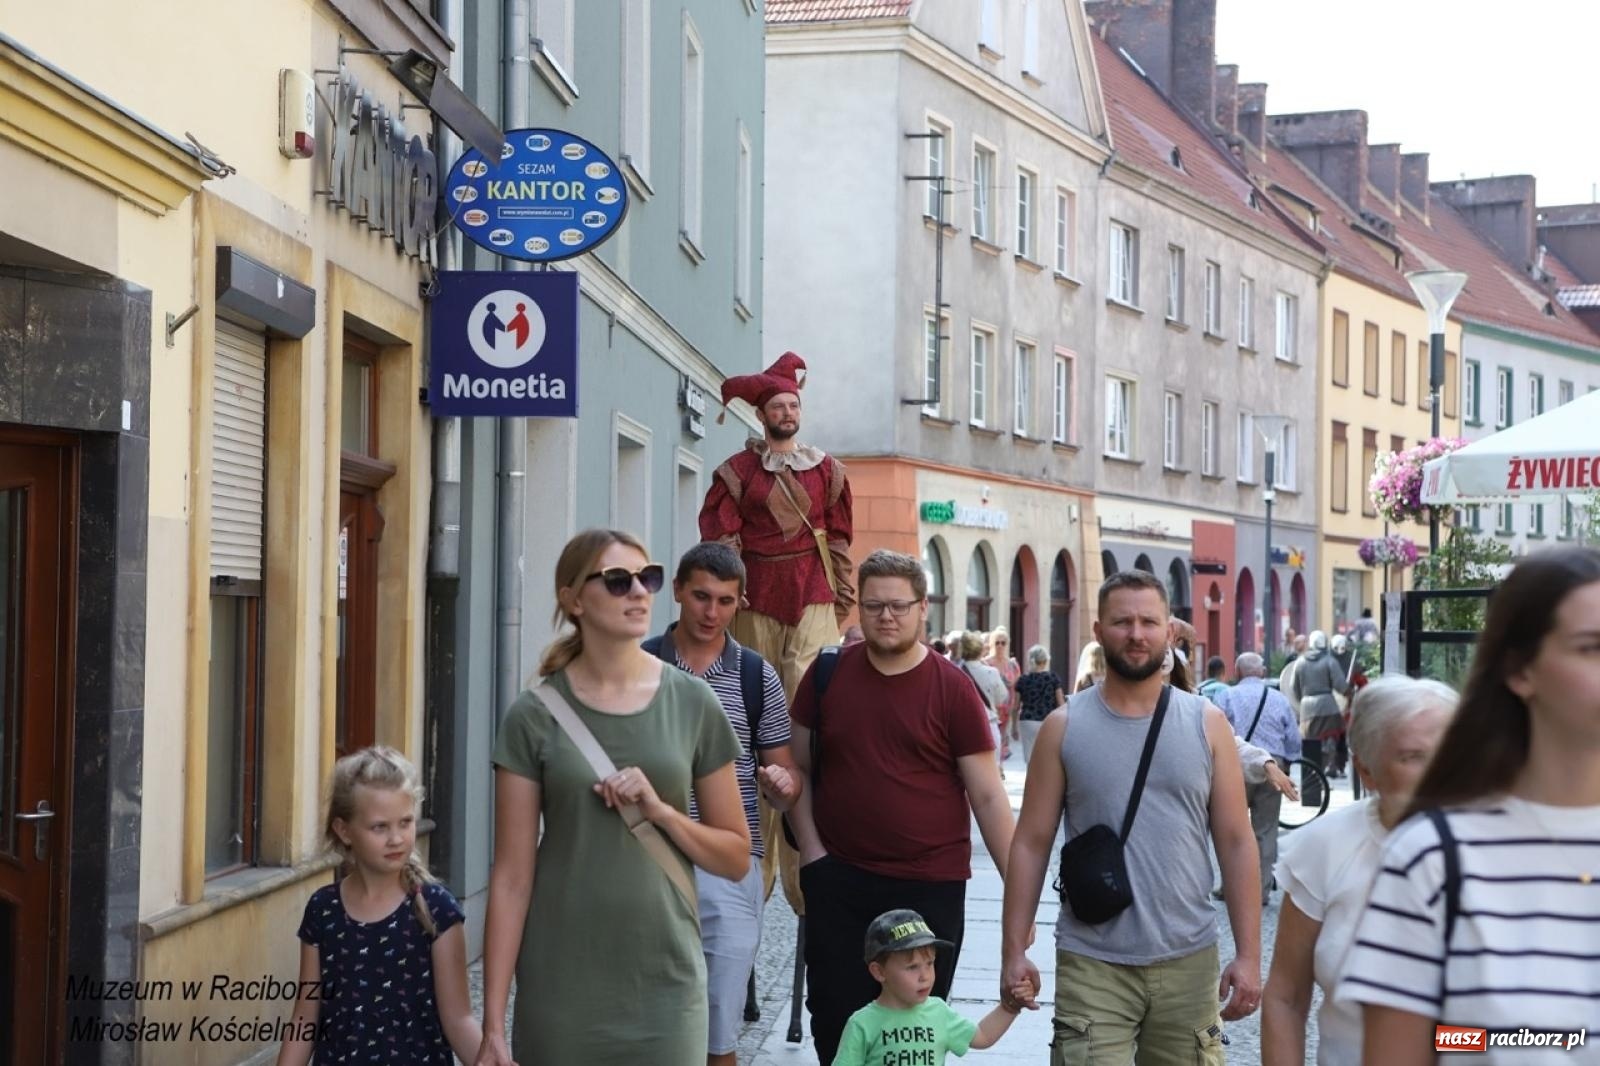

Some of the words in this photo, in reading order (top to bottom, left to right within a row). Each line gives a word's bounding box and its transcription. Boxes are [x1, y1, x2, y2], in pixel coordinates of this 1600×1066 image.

[517, 163, 556, 175] SEZAM
[487, 180, 586, 201] KANTOR
[442, 372, 566, 400] Monetia
[891, 921, 917, 940] NEW
[882, 1026, 935, 1046] MORE
[883, 1049, 935, 1066] GAME
